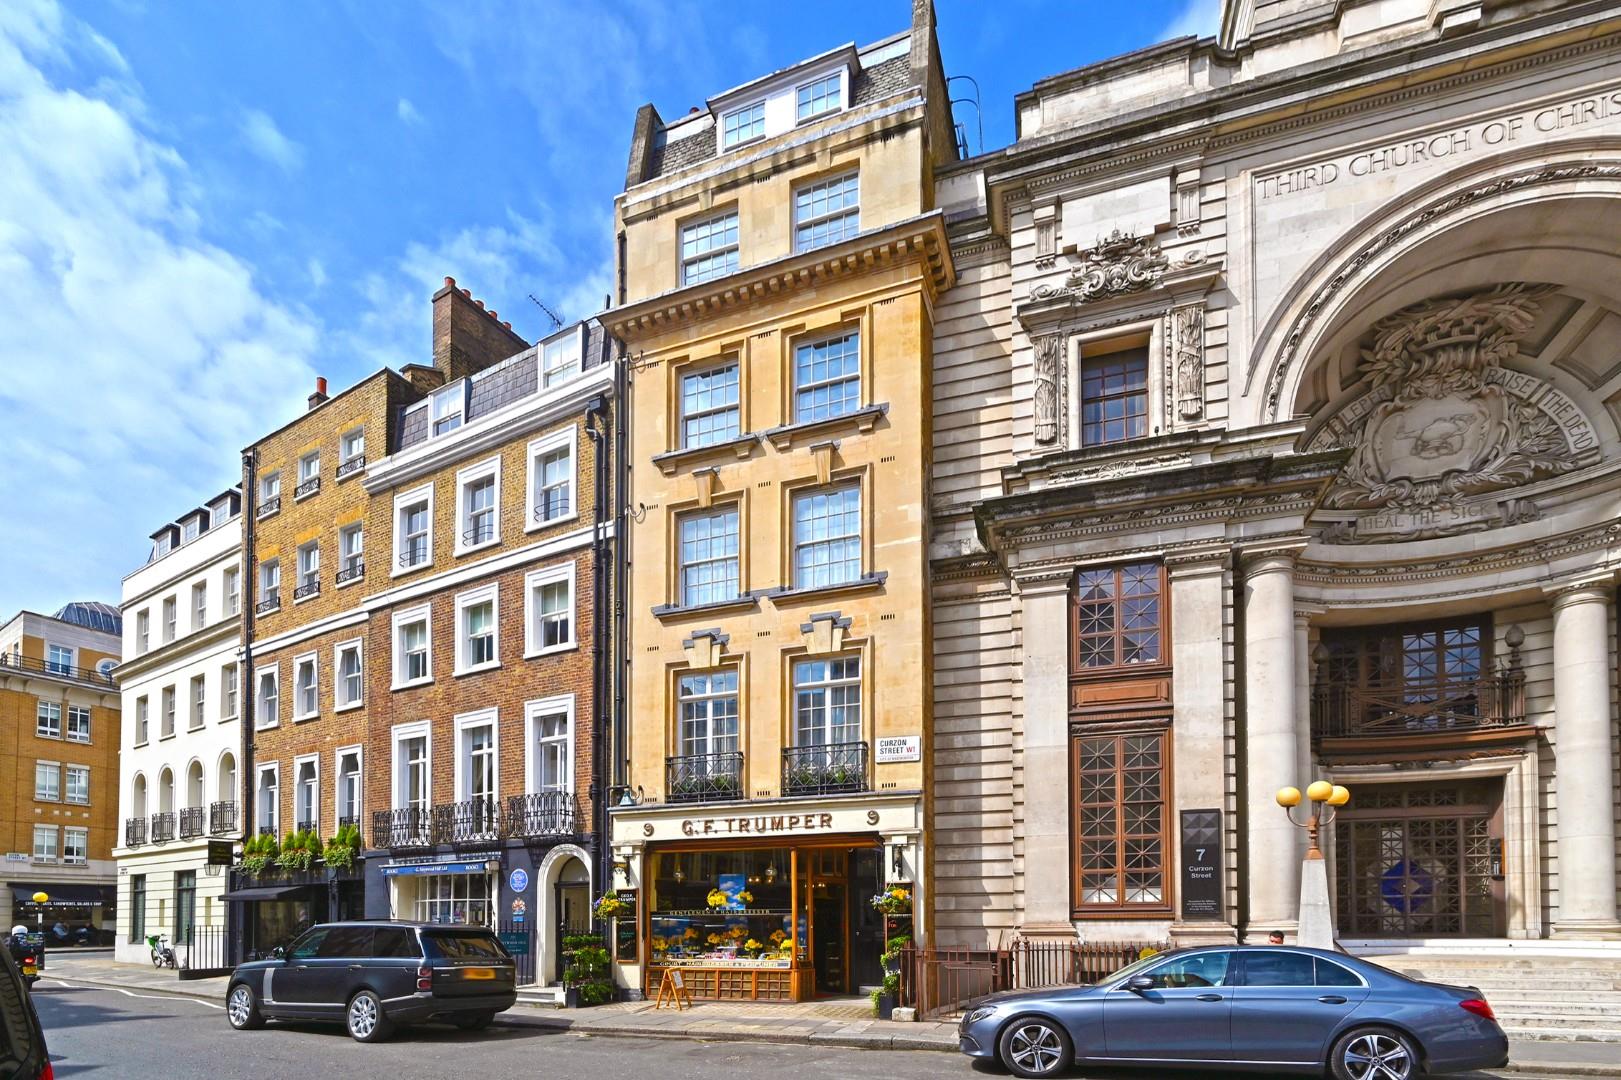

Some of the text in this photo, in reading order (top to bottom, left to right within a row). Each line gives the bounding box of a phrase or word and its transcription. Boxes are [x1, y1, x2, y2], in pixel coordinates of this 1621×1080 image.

[1257, 92, 1621, 199] THIRD CHURCH OF CHRIS
[1485, 368, 1593, 450] RAISE THE DEAD
[1363, 503, 1488, 530] HEAL THE SICK
[880, 739, 907, 747] CURZON
[880, 745, 916, 755] STREET W1
[643, 823, 655, 837] 9
[725, 812, 833, 834] TRUMPER
[866, 810, 880, 826] 9
[1196, 848, 1206, 861] 7
